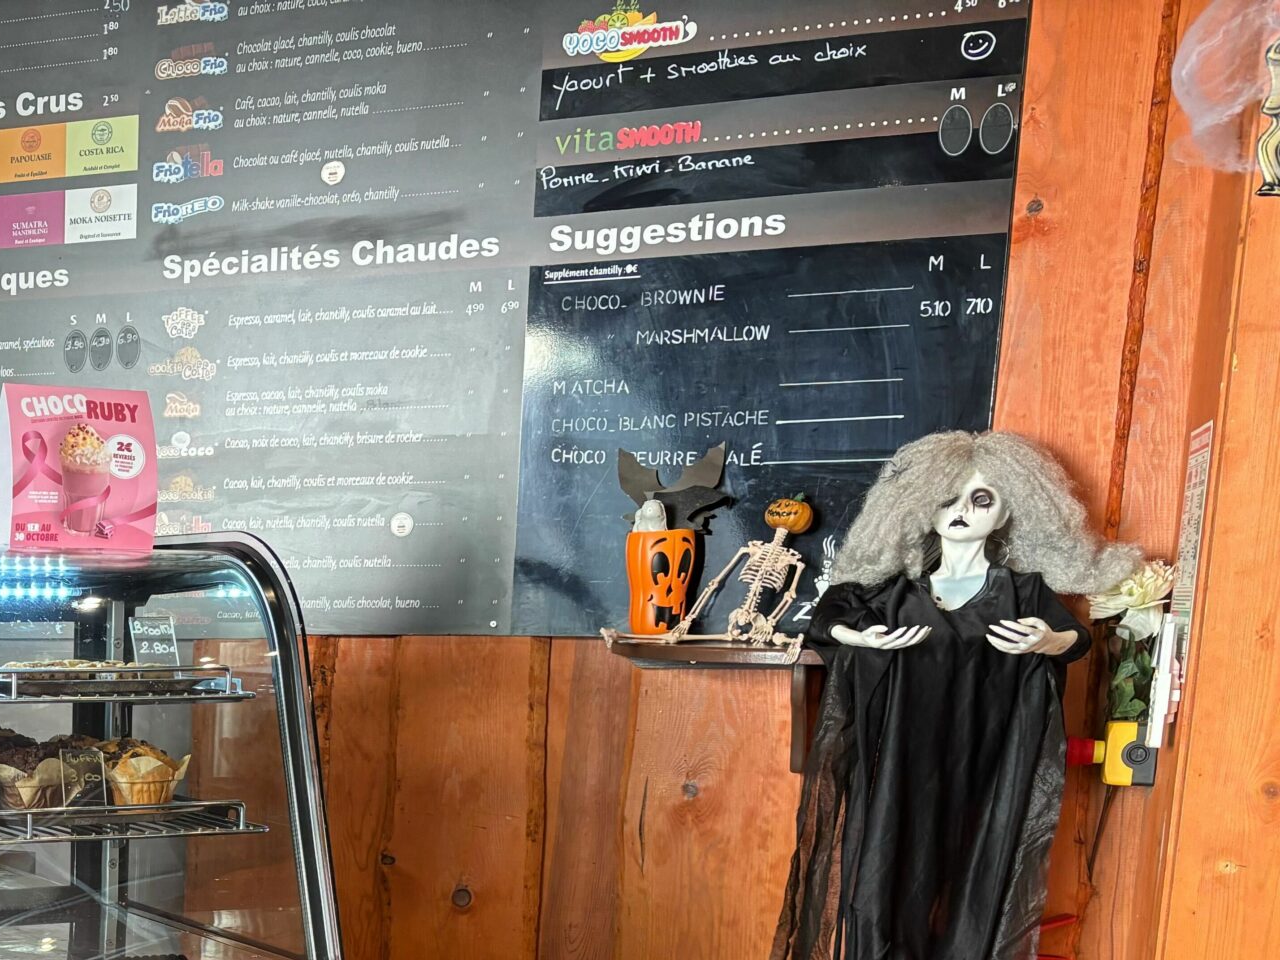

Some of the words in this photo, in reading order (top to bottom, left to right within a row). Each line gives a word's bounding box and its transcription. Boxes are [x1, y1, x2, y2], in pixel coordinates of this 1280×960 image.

[236, 41, 271, 55] Chocolat
[273, 36, 296, 53] glacé,
[297, 30, 334, 47] chantilly,
[335, 27, 359, 42] coulis
[360, 22, 396, 39] chocolat
[275, 57, 303, 69] nature,
[305, 50, 340, 65] cannelle,
[365, 44, 393, 58] cookie,
[396, 40, 423, 53] bueno
[768, 53, 801, 65] au
[814, 42, 867, 62] choix
[235, 96, 255, 110] Café,
[257, 97, 281, 108] cacao,
[301, 86, 337, 104] chantilly,
[339, 84, 362, 99] coulis
[364, 81, 386, 96] moka
[950, 87, 966, 101] M
[16, 91, 84, 116] Crus
[272, 112, 301, 124] nature,
[303, 105, 338, 120] cannelle,
[340, 101, 369, 117] nutella
[10, 152, 52, 164] PAPOUASIE
[79, 147, 104, 157] COSTA
[105, 145, 124, 155] RICA
[233, 154, 267, 168] Chocolat
[281, 149, 298, 164] café
[299, 148, 322, 166] glacé,
[324, 146, 354, 160] nutella,
[356, 140, 392, 157] chantilly,
[394, 137, 419, 152] coulis
[420, 134, 450, 150] nutella
[231, 196, 274, 212] Milk-shake
[364, 185, 400, 202] chantilly
[12, 220, 49, 230] SUMATRA
[69, 216, 93, 226] MOKA
[94, 212, 133, 223] NOISETTE
[549, 212, 787, 256] Suggestions
[162, 243, 340, 284] Spécialités
[351, 233, 501, 267] Chaudes
[928, 254, 944, 272] M
[980, 253, 992, 270] L
[544, 267, 589, 281] Supplément
[589, 264, 623, 278] chantilly
[470, 281, 483, 293] M
[507, 279, 515, 291] L
[640, 284, 726, 308] BROWNIE
[70, 314, 78, 326] S
[95, 312, 107, 324] M
[352, 305, 375, 319] coulis
[377, 303, 409, 316] caramel
[636, 324, 771, 346] MARSHMALLOW
[350, 348, 388, 361] morceaux
[401, 344, 428, 358] cookie
[365, 382, 388, 396] moka
[552, 378, 630, 396] MATCHA
[20, 393, 88, 418] CHOCO
[86, 400, 139, 424] RUBY
[619, 413, 677, 431] BLANC
[684, 409, 770, 427] PISTACHE
[356, 430, 384, 444] brisure
[396, 429, 424, 443] rocher
[551, 447, 606, 465] CHOCO
[726, 442, 764, 467] ALÉ
[336, 474, 375, 487] morceaux
[387, 471, 414, 486] cookie
[15, 523, 25, 533] DU
[41, 523, 52, 533] AU
[357, 512, 385, 527] nutella
[26, 532, 59, 542] OCTOBRE
[363, 553, 392, 568] nutella
[395, 595, 420, 609] bueno
